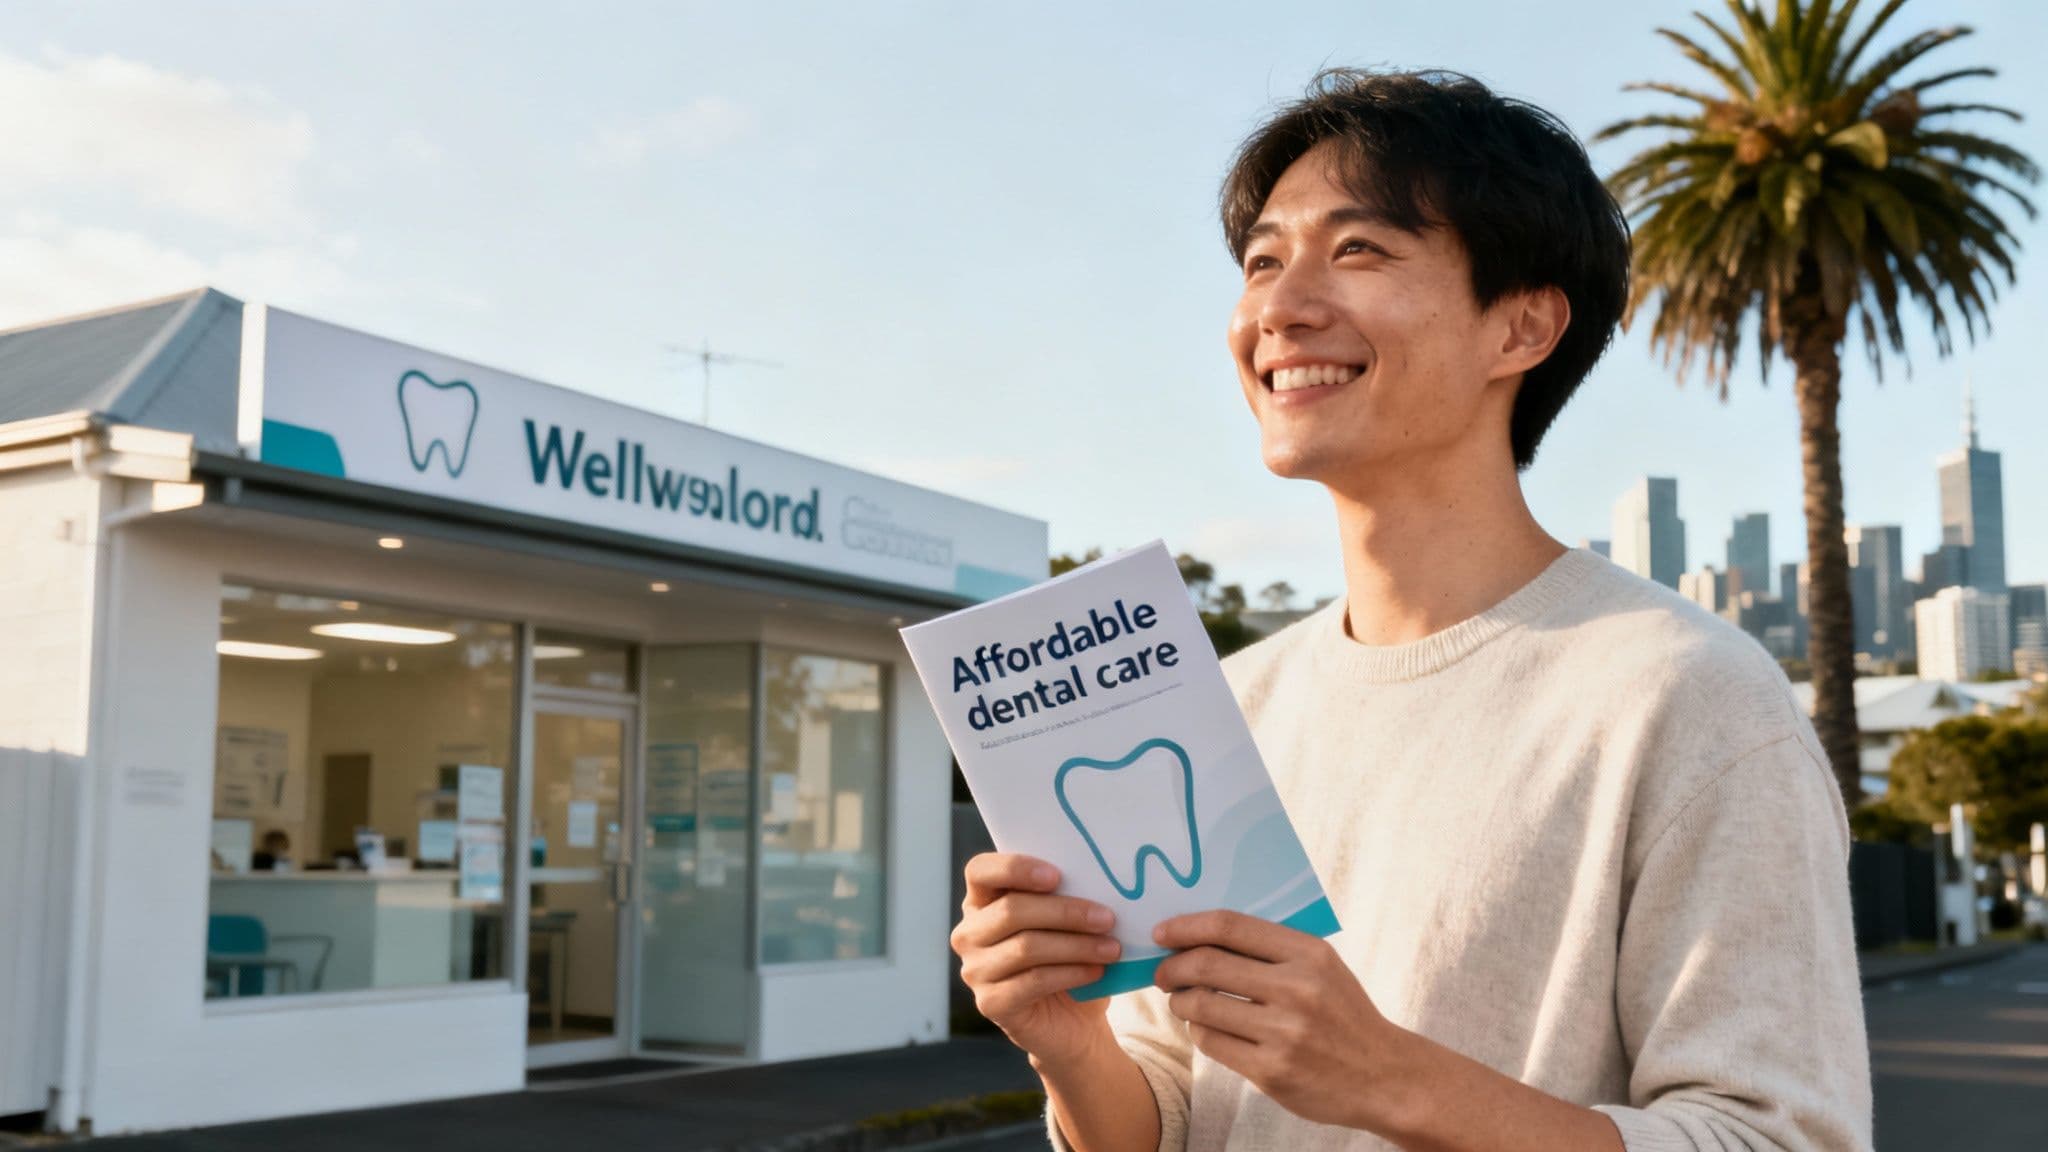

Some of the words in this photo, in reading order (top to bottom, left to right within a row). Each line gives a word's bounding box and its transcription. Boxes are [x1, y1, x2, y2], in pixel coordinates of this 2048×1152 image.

[952, 600, 1158, 694] Affordable
[967, 664, 1089, 731] dental
[1096, 642, 1180, 690] care
